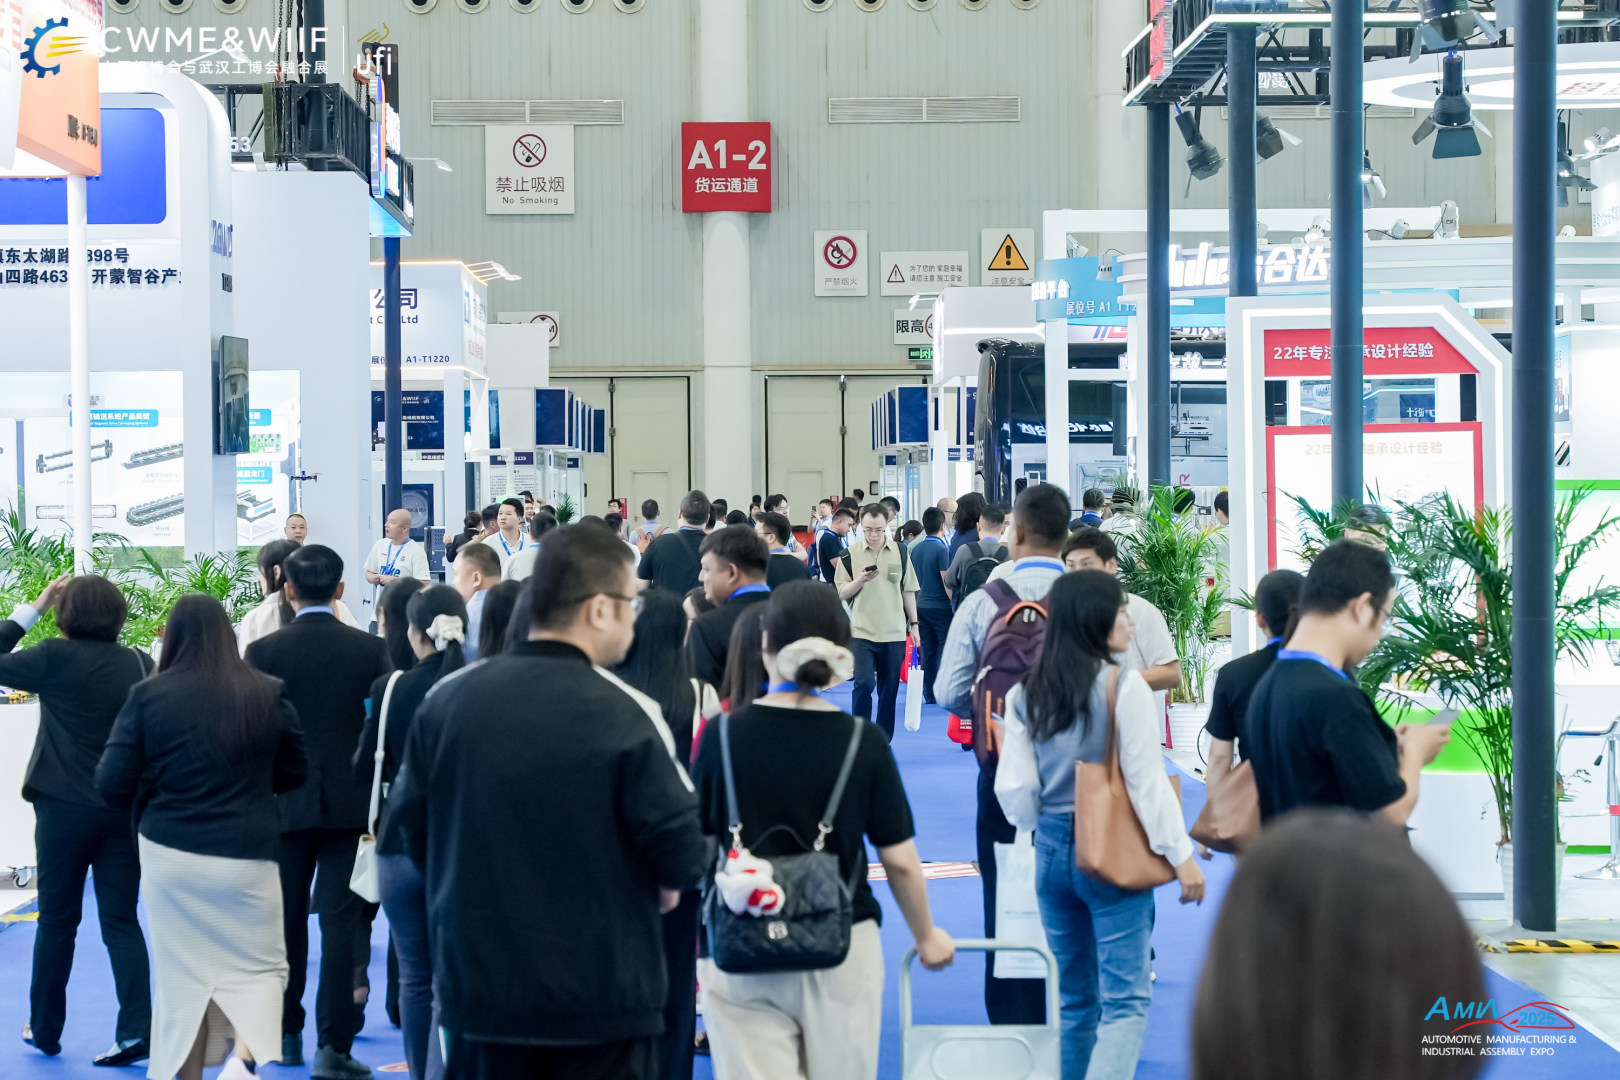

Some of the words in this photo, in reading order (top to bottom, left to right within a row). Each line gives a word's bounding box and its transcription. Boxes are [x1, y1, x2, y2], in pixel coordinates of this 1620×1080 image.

[687, 139, 767, 170] A1-2
[495, 176, 565, 193] 禁止吸烟
[694, 177, 759, 194] 货运通道
[502, 196, 514, 204] No
[520, 196, 559, 206] Smoking
[823, 277, 858, 286] 严禁烟火
[896, 319, 925, 333] 限高
[405, 355, 450, 363] A1-T1220
